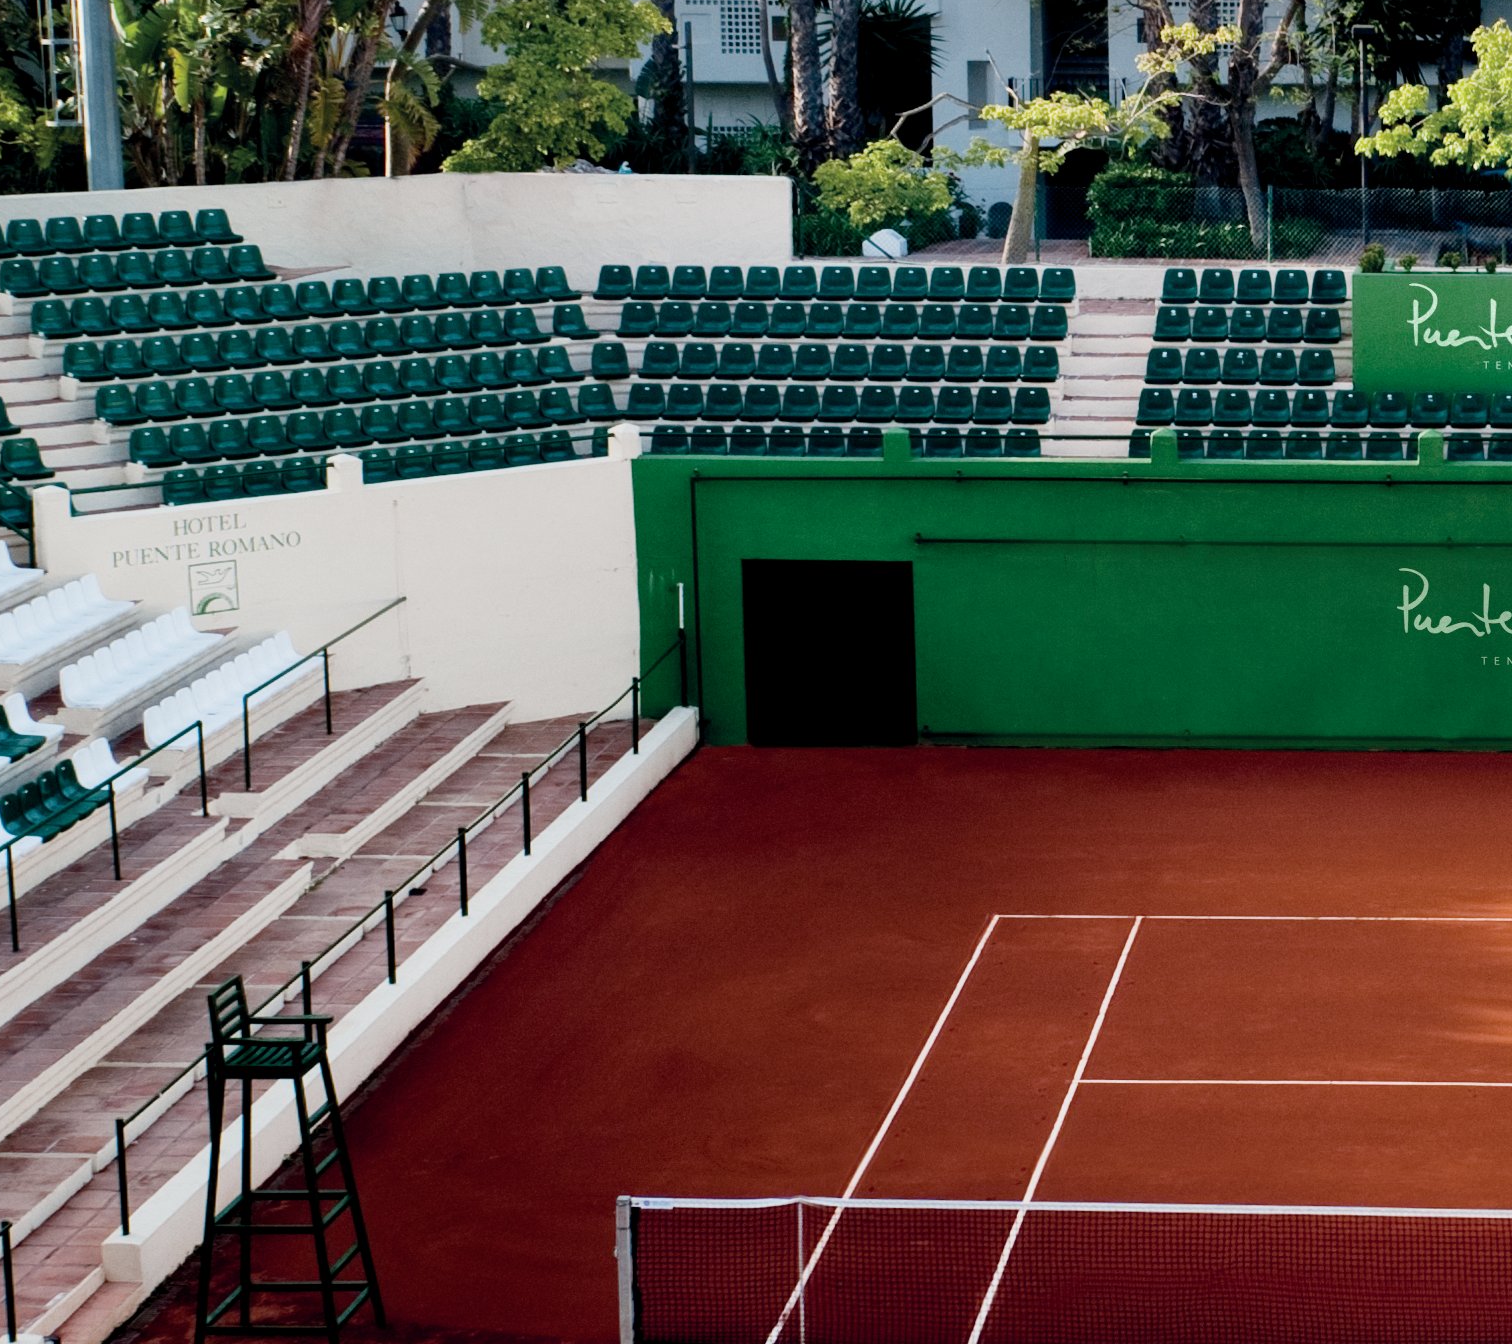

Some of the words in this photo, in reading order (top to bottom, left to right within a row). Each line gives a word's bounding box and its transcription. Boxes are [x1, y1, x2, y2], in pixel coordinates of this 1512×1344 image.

[173, 512, 247, 537] HOTEL
[112, 542, 201, 568] PUENTE
[208, 530, 302, 557] ROMANO
